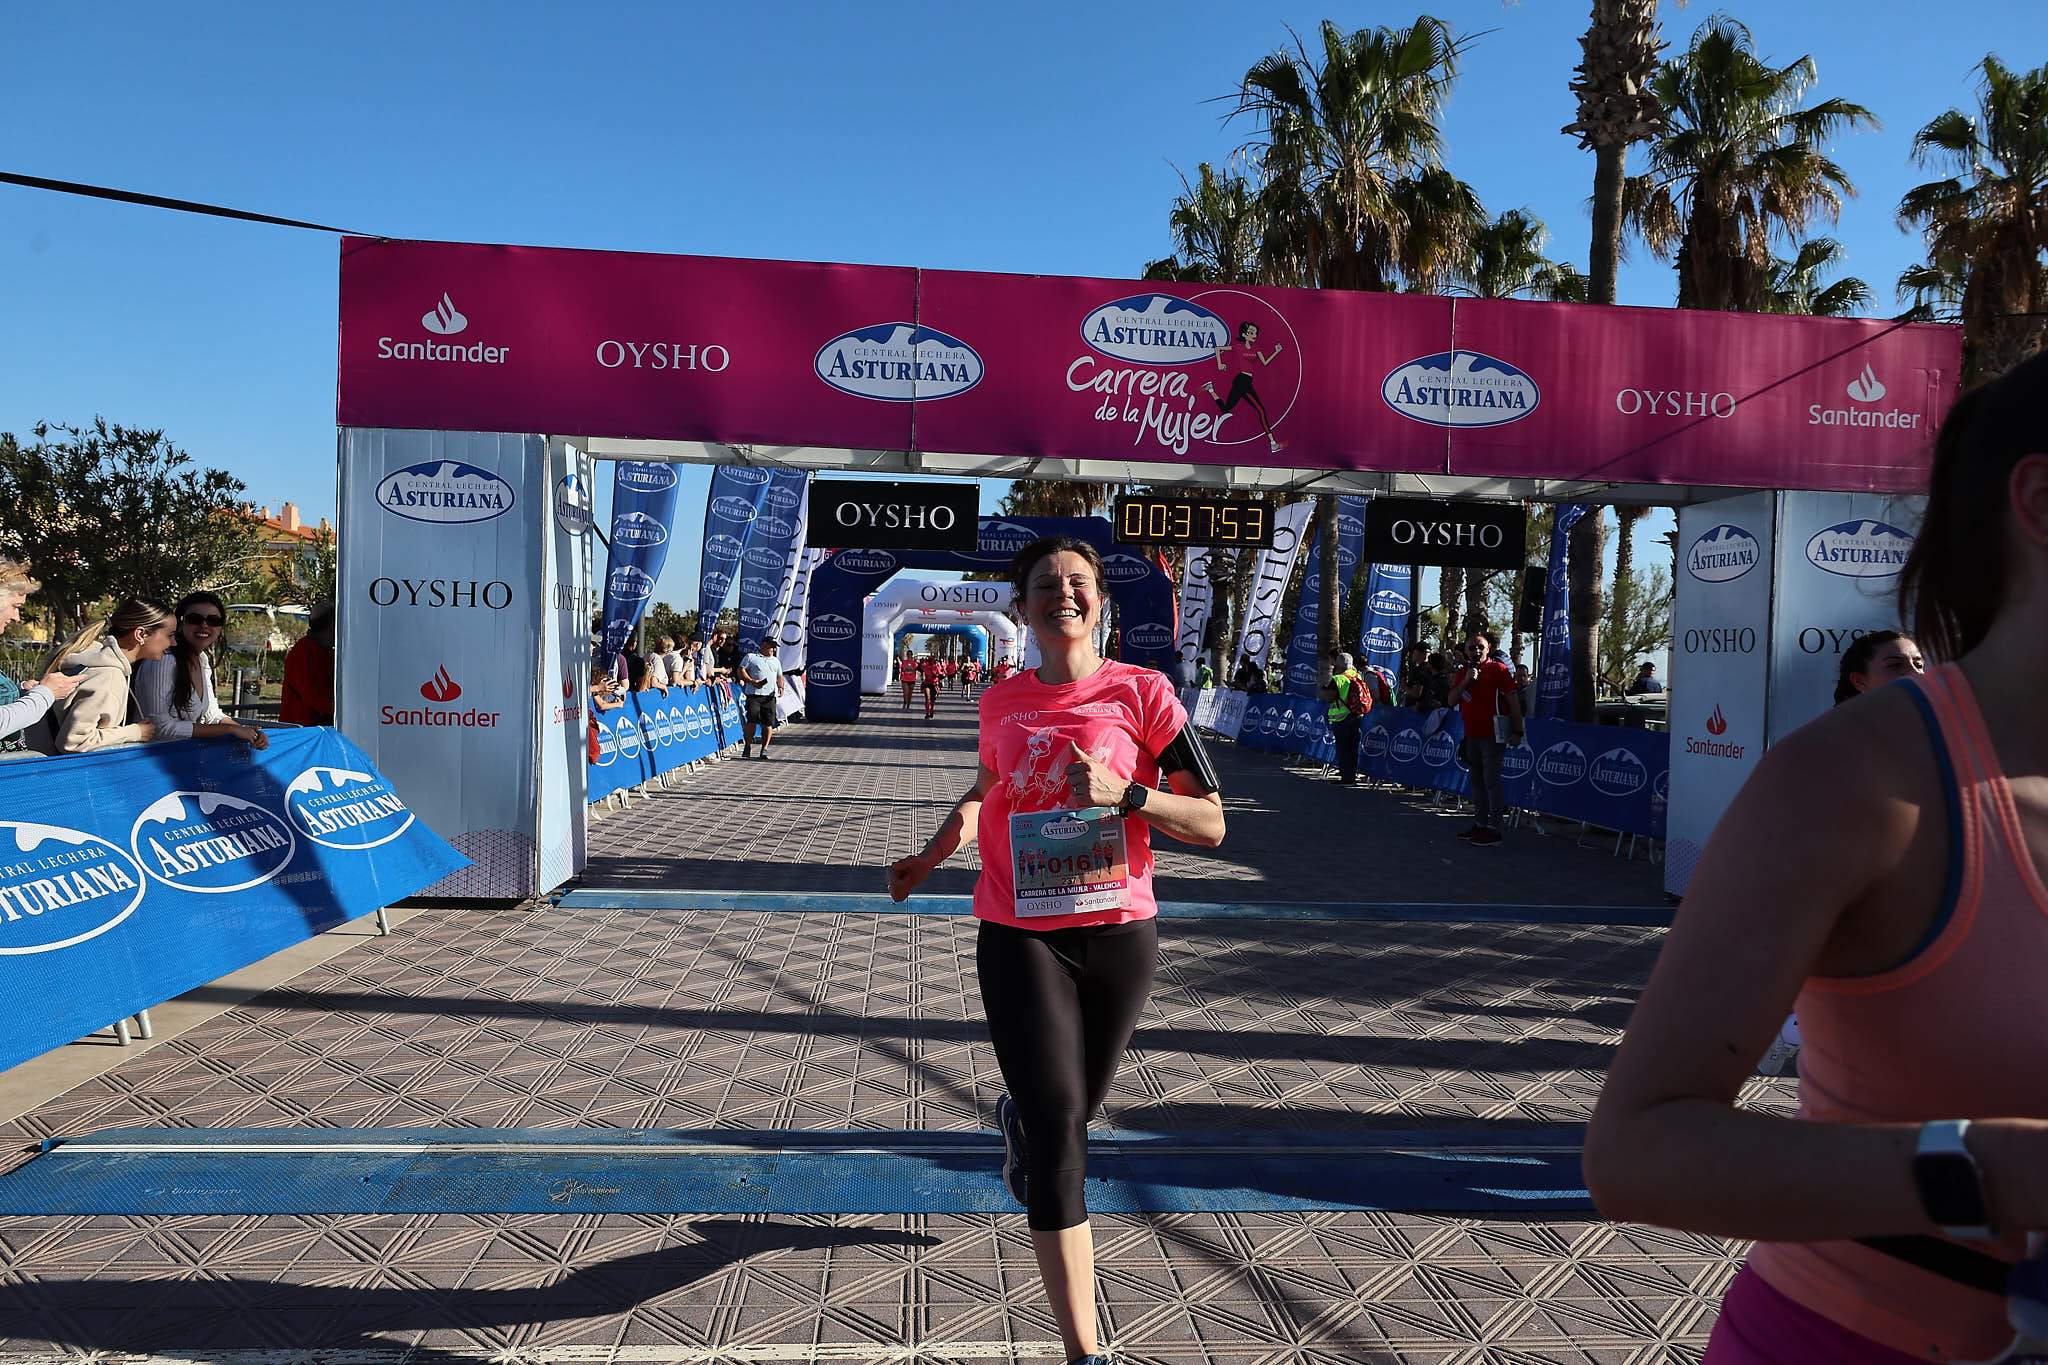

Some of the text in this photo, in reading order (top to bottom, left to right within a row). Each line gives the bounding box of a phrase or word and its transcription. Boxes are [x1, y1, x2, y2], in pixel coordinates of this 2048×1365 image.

[1093, 316, 1218, 349] ASTURIANA
[1115, 316, 1215, 328] CENTRAL LECHERA
[378, 337, 509, 364] Santander
[596, 340, 731, 373] OYSHO
[855, 348, 908, 358] CENTRAL
[828, 349, 971, 383] ASTURIANA
[1066, 356, 1189, 398] Carrera
[1393, 376, 1527, 409] ASTURIANA
[1419, 375, 1523, 387] CENTRAL LECHERA
[1616, 388, 1737, 418] OYSHO
[1095, 394, 1233, 455] de la Mujer
[1808, 404, 1920, 429] Santander
[386, 481, 504, 509] ASTURIANA
[407, 480, 501, 491] CENTRAL LECHERA
[836, 501, 955, 531] OYSHO
[1125, 503, 1262, 540] 00:37:53
[1391, 519, 1503, 549] OYSHO
[837, 552, 891, 568] ASTURIANA
[1691, 549, 1753, 571] ASTURIANA
[368, 577, 513, 610] OYSHO
[553, 582, 588, 613] OYSHO
[920, 585, 999, 604] OYSHO
[1244, 526, 1297, 656] OYSHO
[810, 619, 853, 635] ASTURIANA
[1684, 627, 1756, 653] OYSHO
[808, 665, 850, 681] ASTURIANA
[381, 705, 500, 728] Santander
[1000, 710, 1038, 726] OYSHO
[1686, 736, 1745, 761] Santander
[1540, 754, 1582, 777] ASTURIANA
[1592, 763, 1639, 787] ASTURIANA
[308, 792, 347, 807] CENTRAL
[164, 812, 264, 841] CENTRAL LECHERA
[297, 792, 407, 837] ASTURIANA
[1043, 824, 1087, 836] ASTURIANA
[37, 847, 107, 870] LECHERA
[148, 824, 289, 879] ASTURIANA
[0, 862, 138, 924] TURIANA
[1020, 887, 1047, 898] CARRERA
[1047, 887, 1057, 896] DE
[1057, 886, 1066, 895] LA
[1067, 884, 1088, 894] MUJER
[1093, 881, 1121, 890] VALENCIA
[1084, 895, 1118, 906] Santander
[1026, 900, 1062, 911] OYSHO
